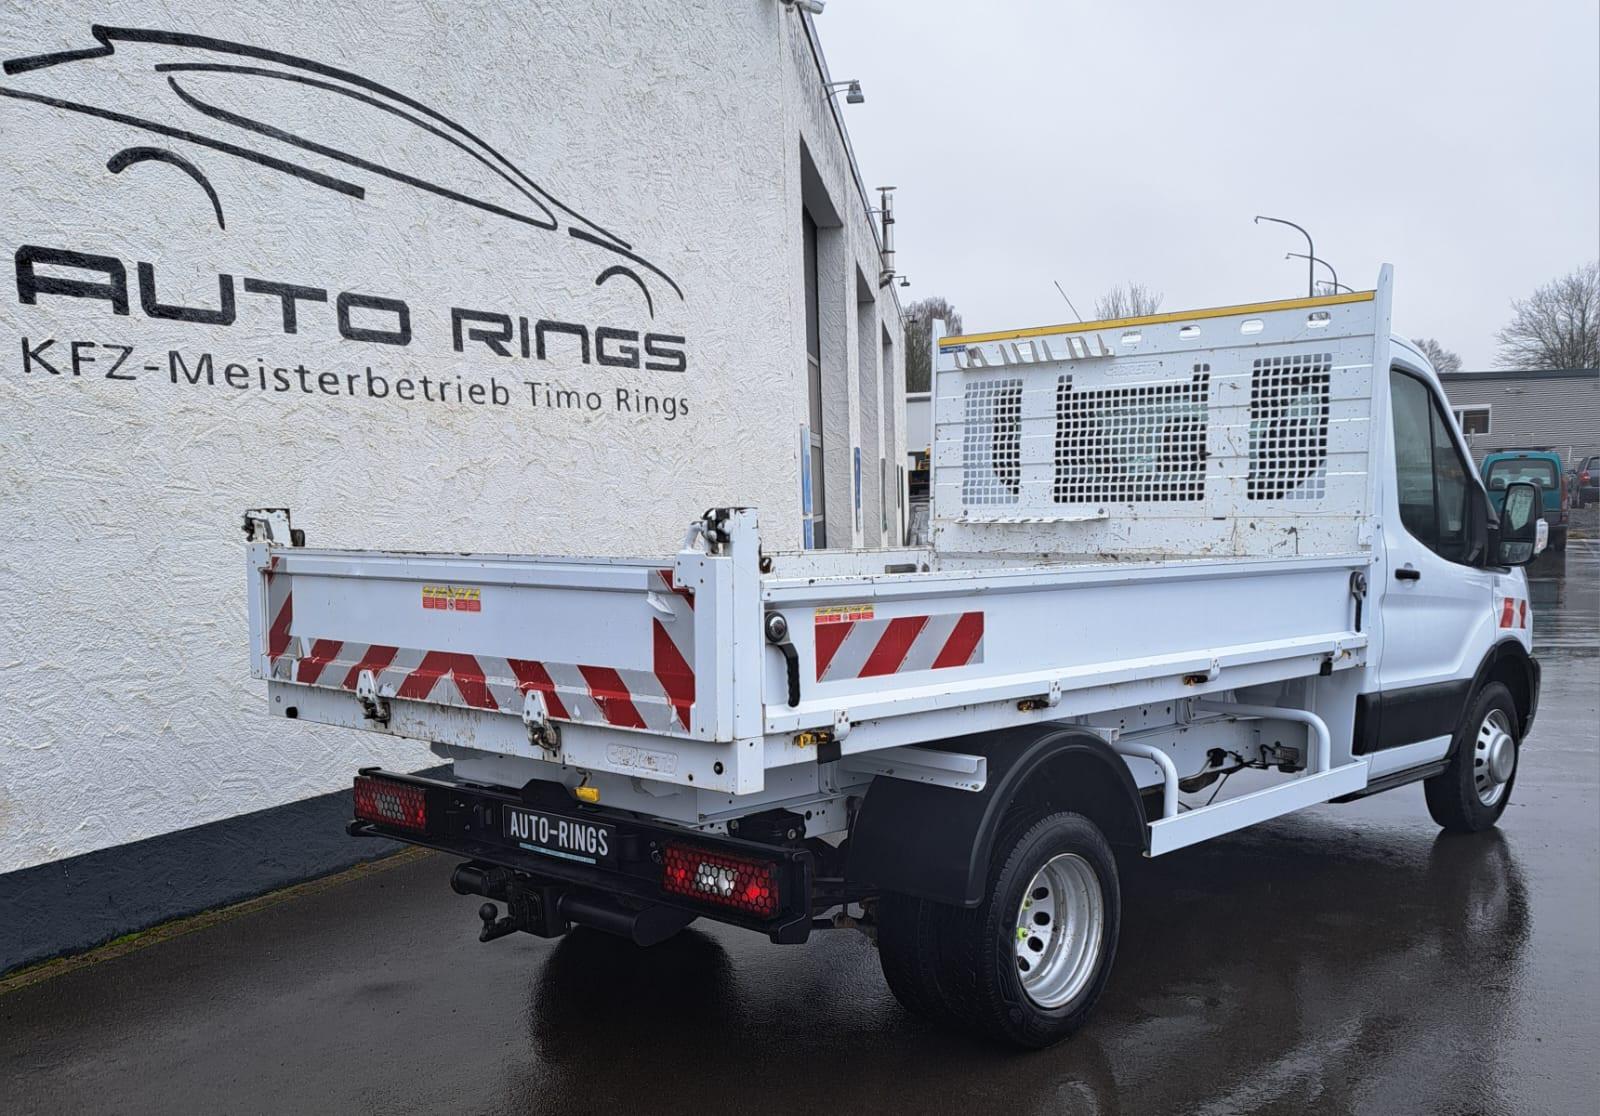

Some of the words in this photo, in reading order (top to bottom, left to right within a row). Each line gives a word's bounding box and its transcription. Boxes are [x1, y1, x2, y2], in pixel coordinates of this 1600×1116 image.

[14, 244, 412, 347] AUTO
[451, 307, 687, 373] RINGS
[21, 337, 510, 406] KFZ-Meisterbetrieb
[524, 381, 602, 411] Timo
[616, 388, 690, 421] Rings
[510, 811, 609, 857] AUTO-RINGS
